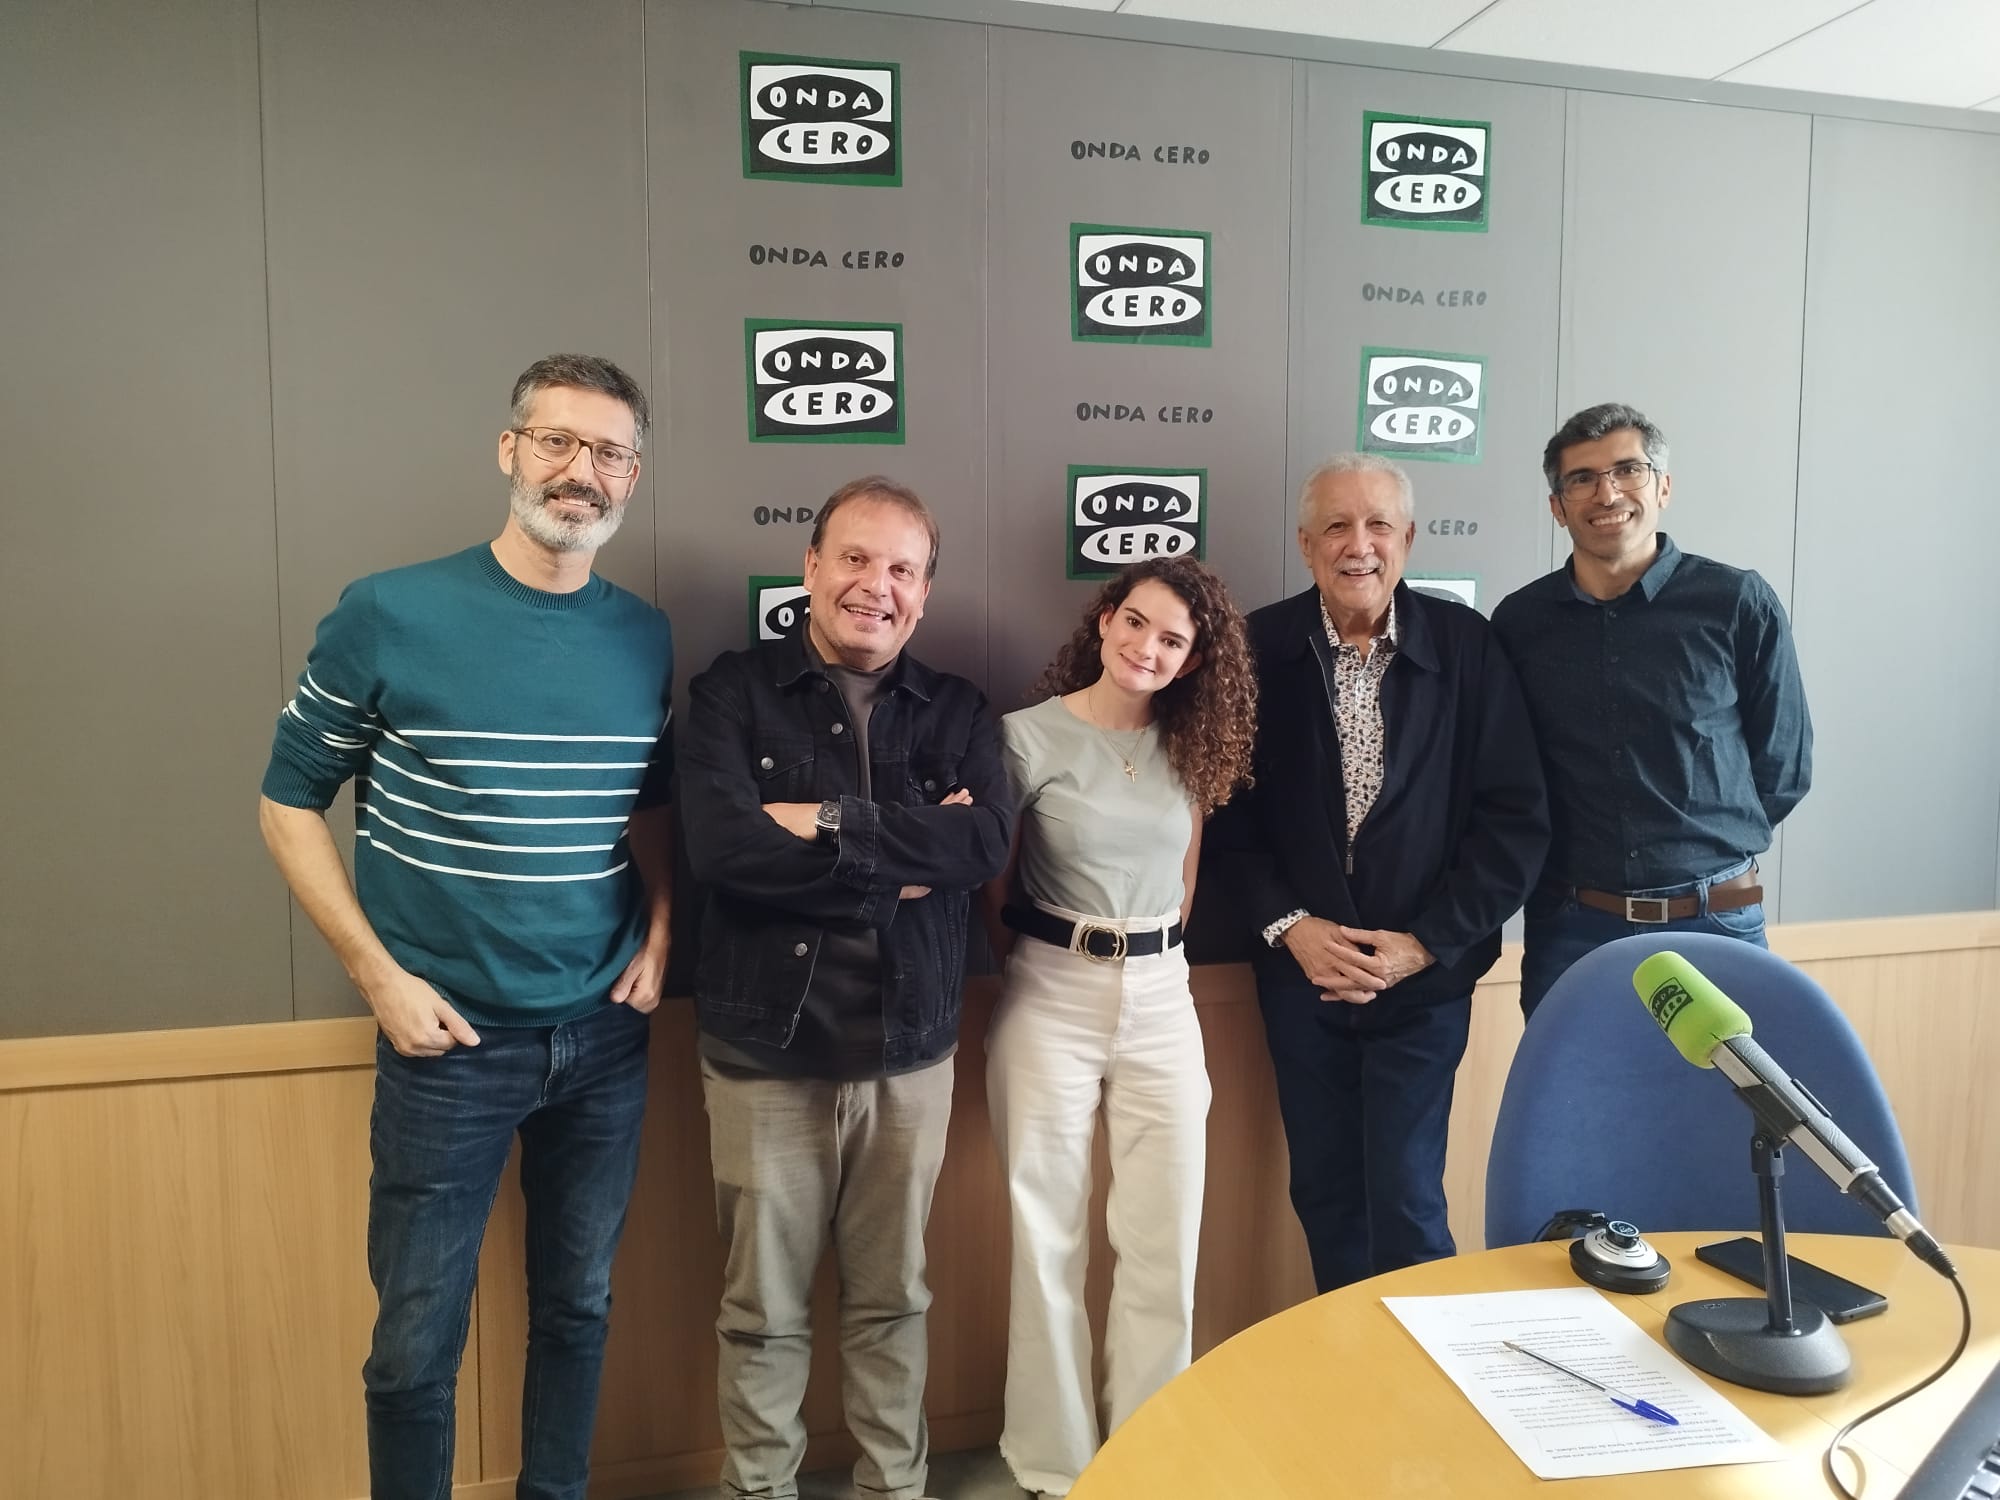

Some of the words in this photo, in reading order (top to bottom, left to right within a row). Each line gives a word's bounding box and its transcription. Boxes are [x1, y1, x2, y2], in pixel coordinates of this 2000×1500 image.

[769, 86, 872, 111] ONDA
[777, 129, 873, 155] CERO
[1071, 140, 1141, 161] ONDA
[1154, 145, 1209, 165] CERO
[1386, 142, 1469, 165] ONDA
[1391, 182, 1466, 204] CERO
[749, 245, 827, 268] ONDA
[842, 250, 904, 270] CERO
[1096, 255, 1186, 276] ONDA
[1102, 295, 1186, 317] CERO
[1362, 283, 1425, 305] ONDA
[1437, 290, 1487, 307] CERO
[775, 351, 875, 373] ONDA
[1383, 376, 1463, 398] ONDA
[782, 392, 876, 415] CERO
[1076, 403, 1145, 423] ONDA
[1158, 405, 1213, 424] CERO
[1386, 414, 1461, 435] CERO
[1092, 493, 1182, 514] ONDA
[754, 506, 817, 525] OND
[1428, 520, 1478, 535] CERO
[1097, 534, 1182, 555] CERO
